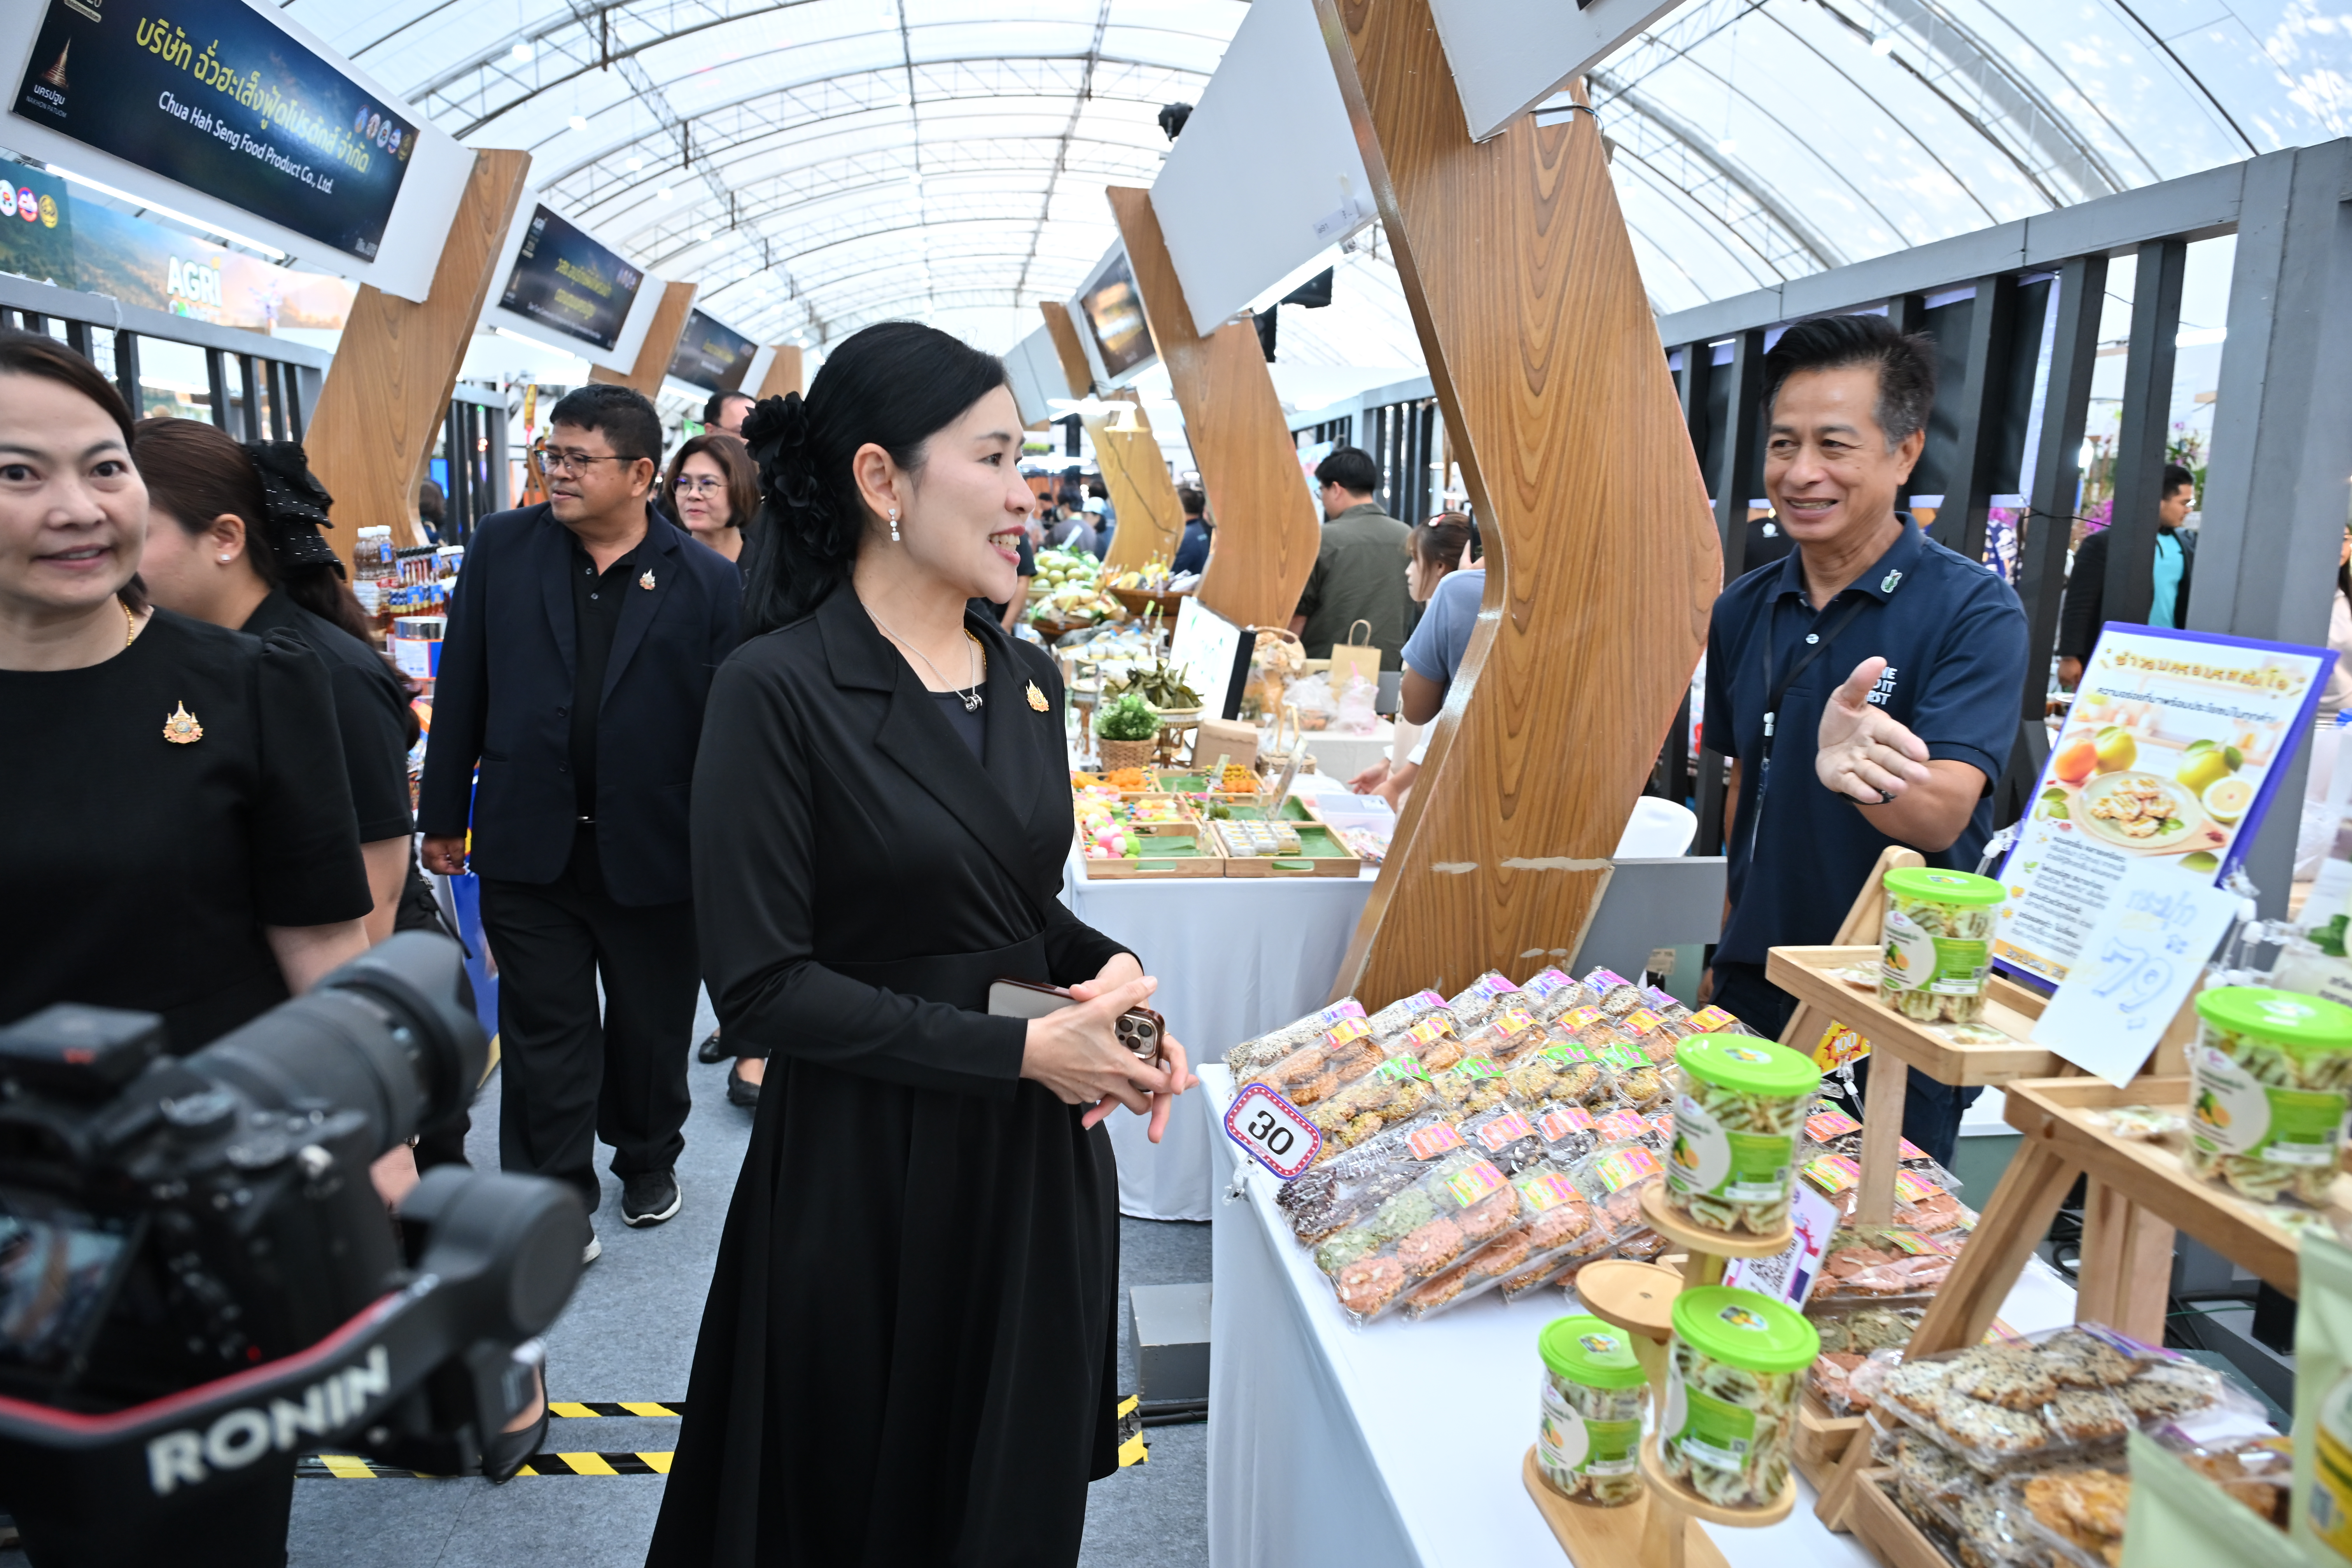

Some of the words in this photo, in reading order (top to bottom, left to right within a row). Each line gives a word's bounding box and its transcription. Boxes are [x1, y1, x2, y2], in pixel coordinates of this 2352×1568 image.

[26, 95, 47, 110] NAKHON
[33, 84, 65, 106] นครปฐม
[136, 17, 192, 70] บริษัท
[337, 131, 370, 173] จำกัด
[159, 91, 189, 120] Chua
[189, 107, 213, 133] Hah
[213, 119, 241, 150] Seng
[240, 133, 267, 159] Food
[264, 144, 301, 179] Product
[317, 174, 334, 194] Ltd.
[2091, 935, 2174, 1014] 79
[1834, 1032, 1857, 1054] 100
[1248, 1110, 1294, 1155] 30
[145, 1342, 390, 1497] RONIN
